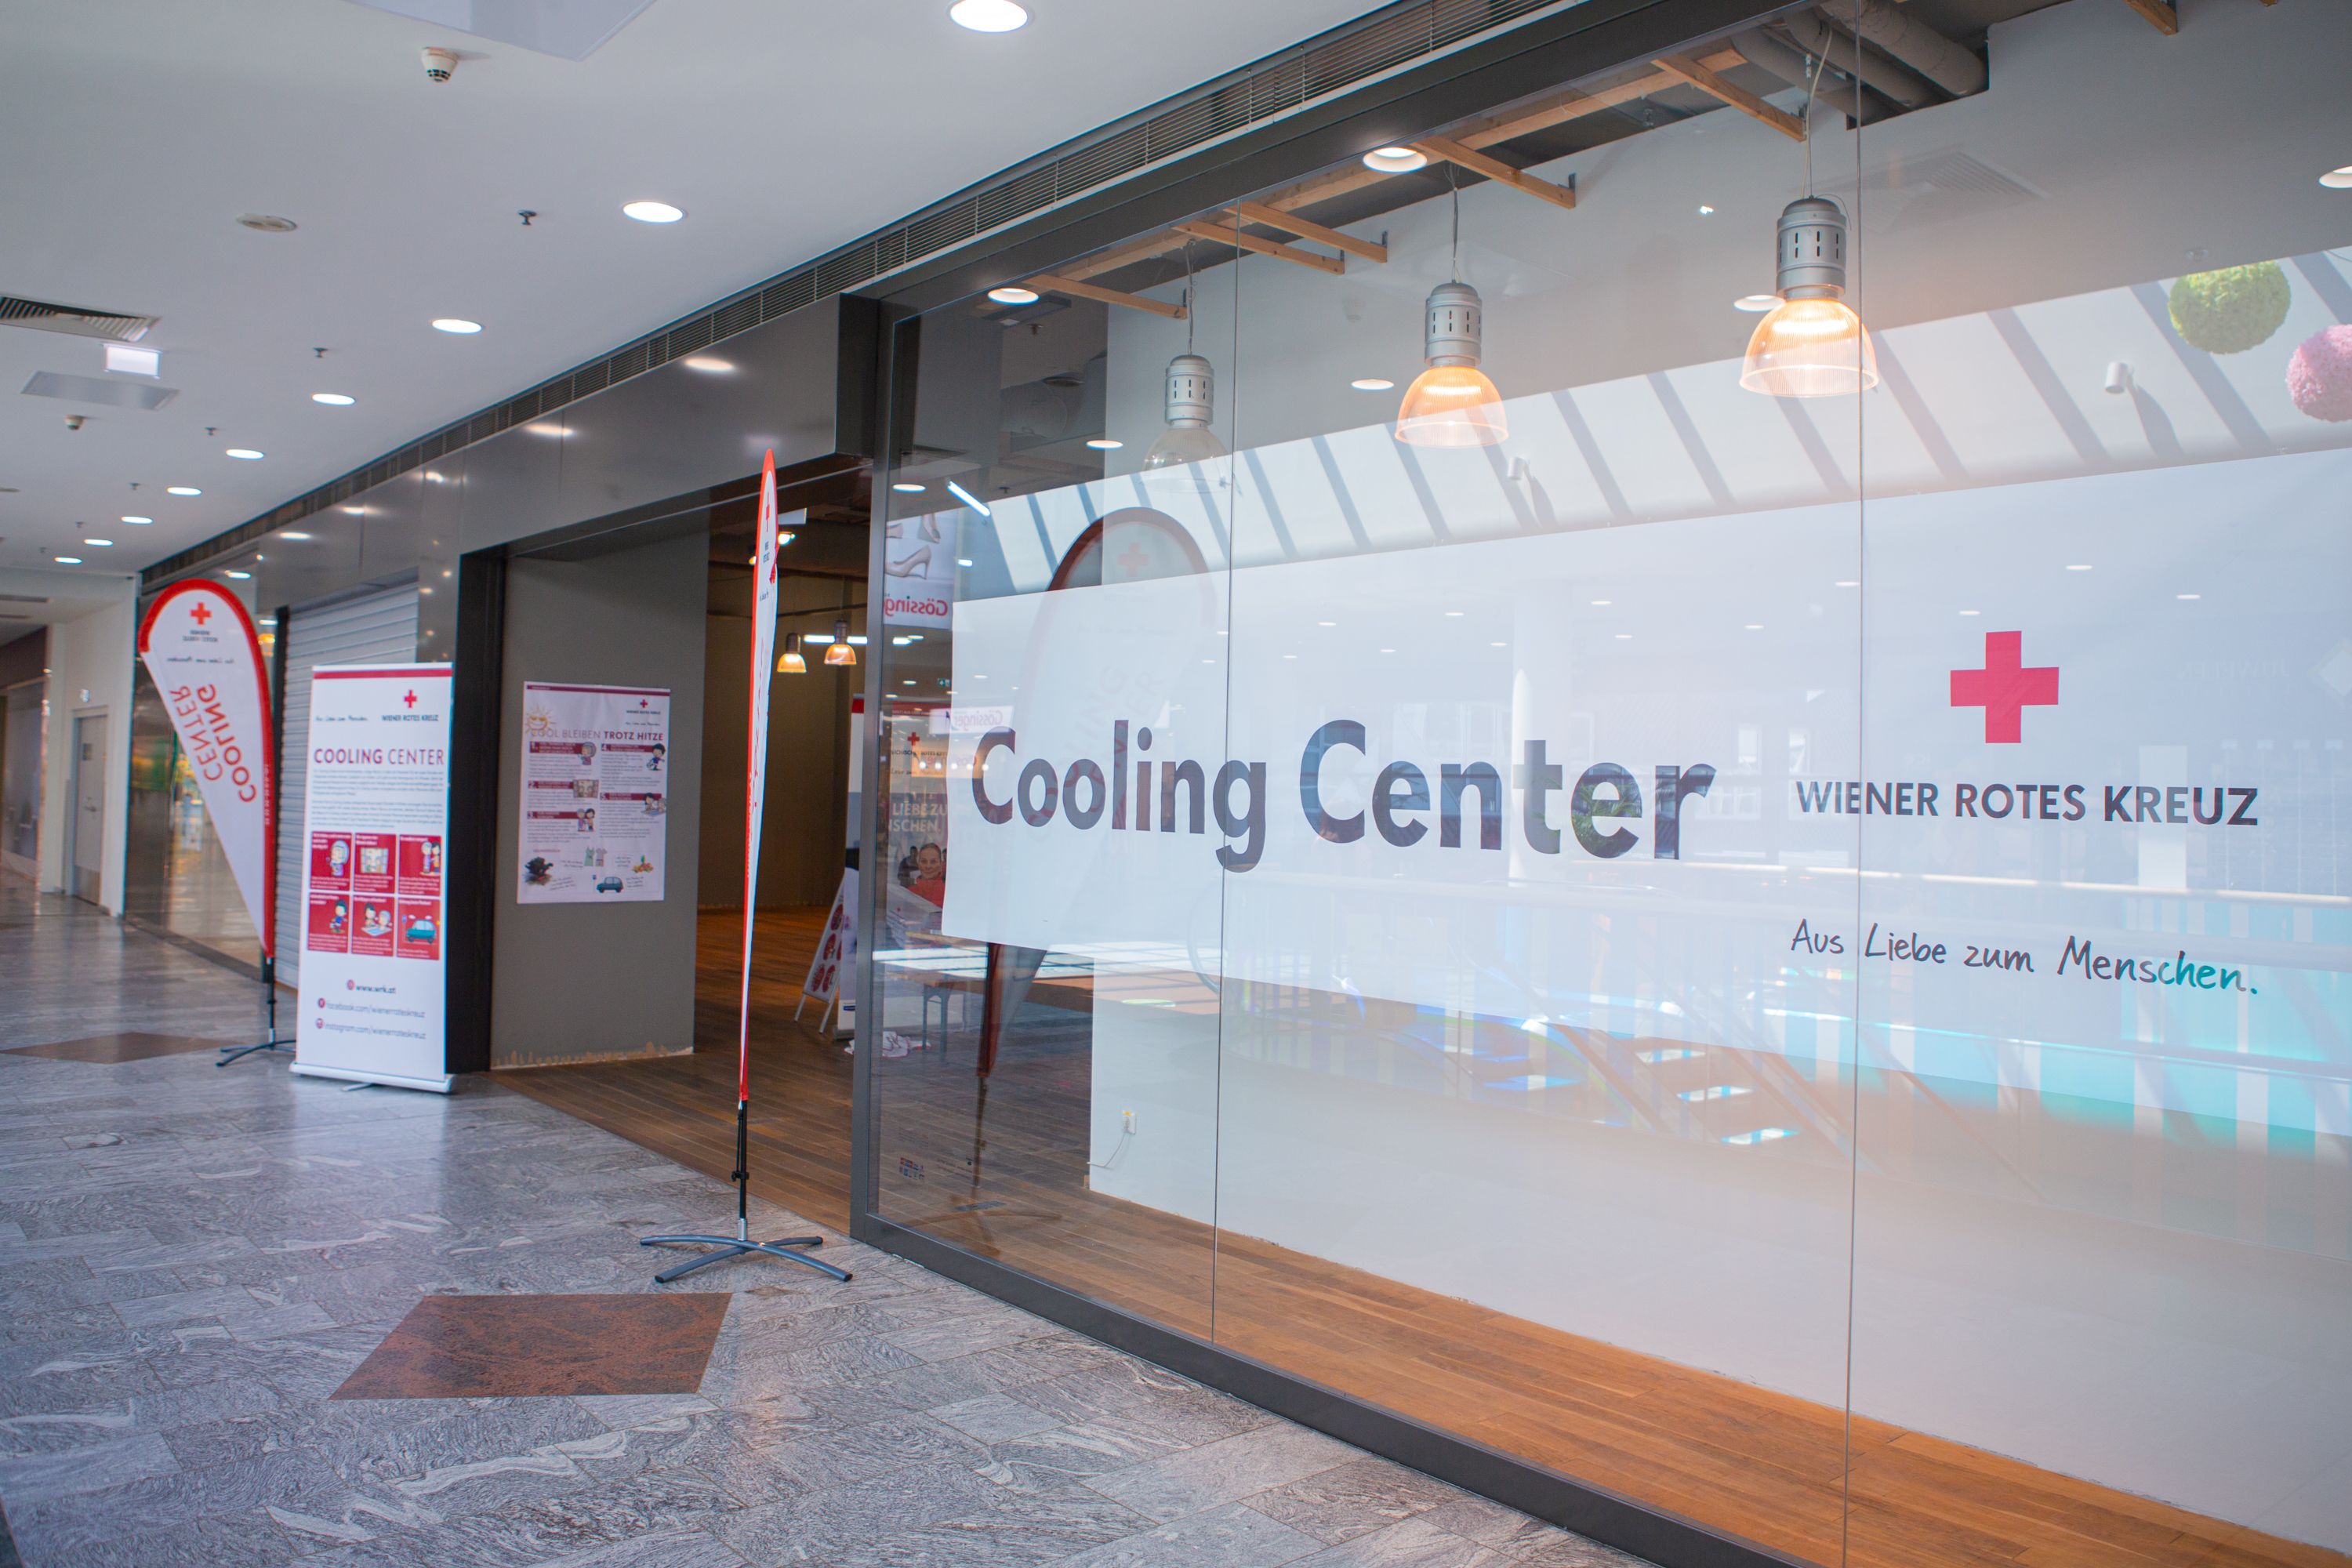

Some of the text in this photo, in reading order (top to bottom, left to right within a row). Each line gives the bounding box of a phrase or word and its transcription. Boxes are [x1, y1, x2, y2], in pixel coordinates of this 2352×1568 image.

[562, 729, 601, 739] BLEIBEN
[604, 731, 634, 741] TROTZ
[637, 732, 664, 742] HITZE
[314, 748, 445, 765] COOLING CENTER
[971, 719, 1717, 873] Cooling Center
[1795, 781, 2258, 826] WIENER ROTES KREUZ
[891, 802, 928, 816] LIEBE
[1790, 918, 2258, 995] Aus Liebe zum Menschen.
[356, 985, 396, 993] www.wrk.at
